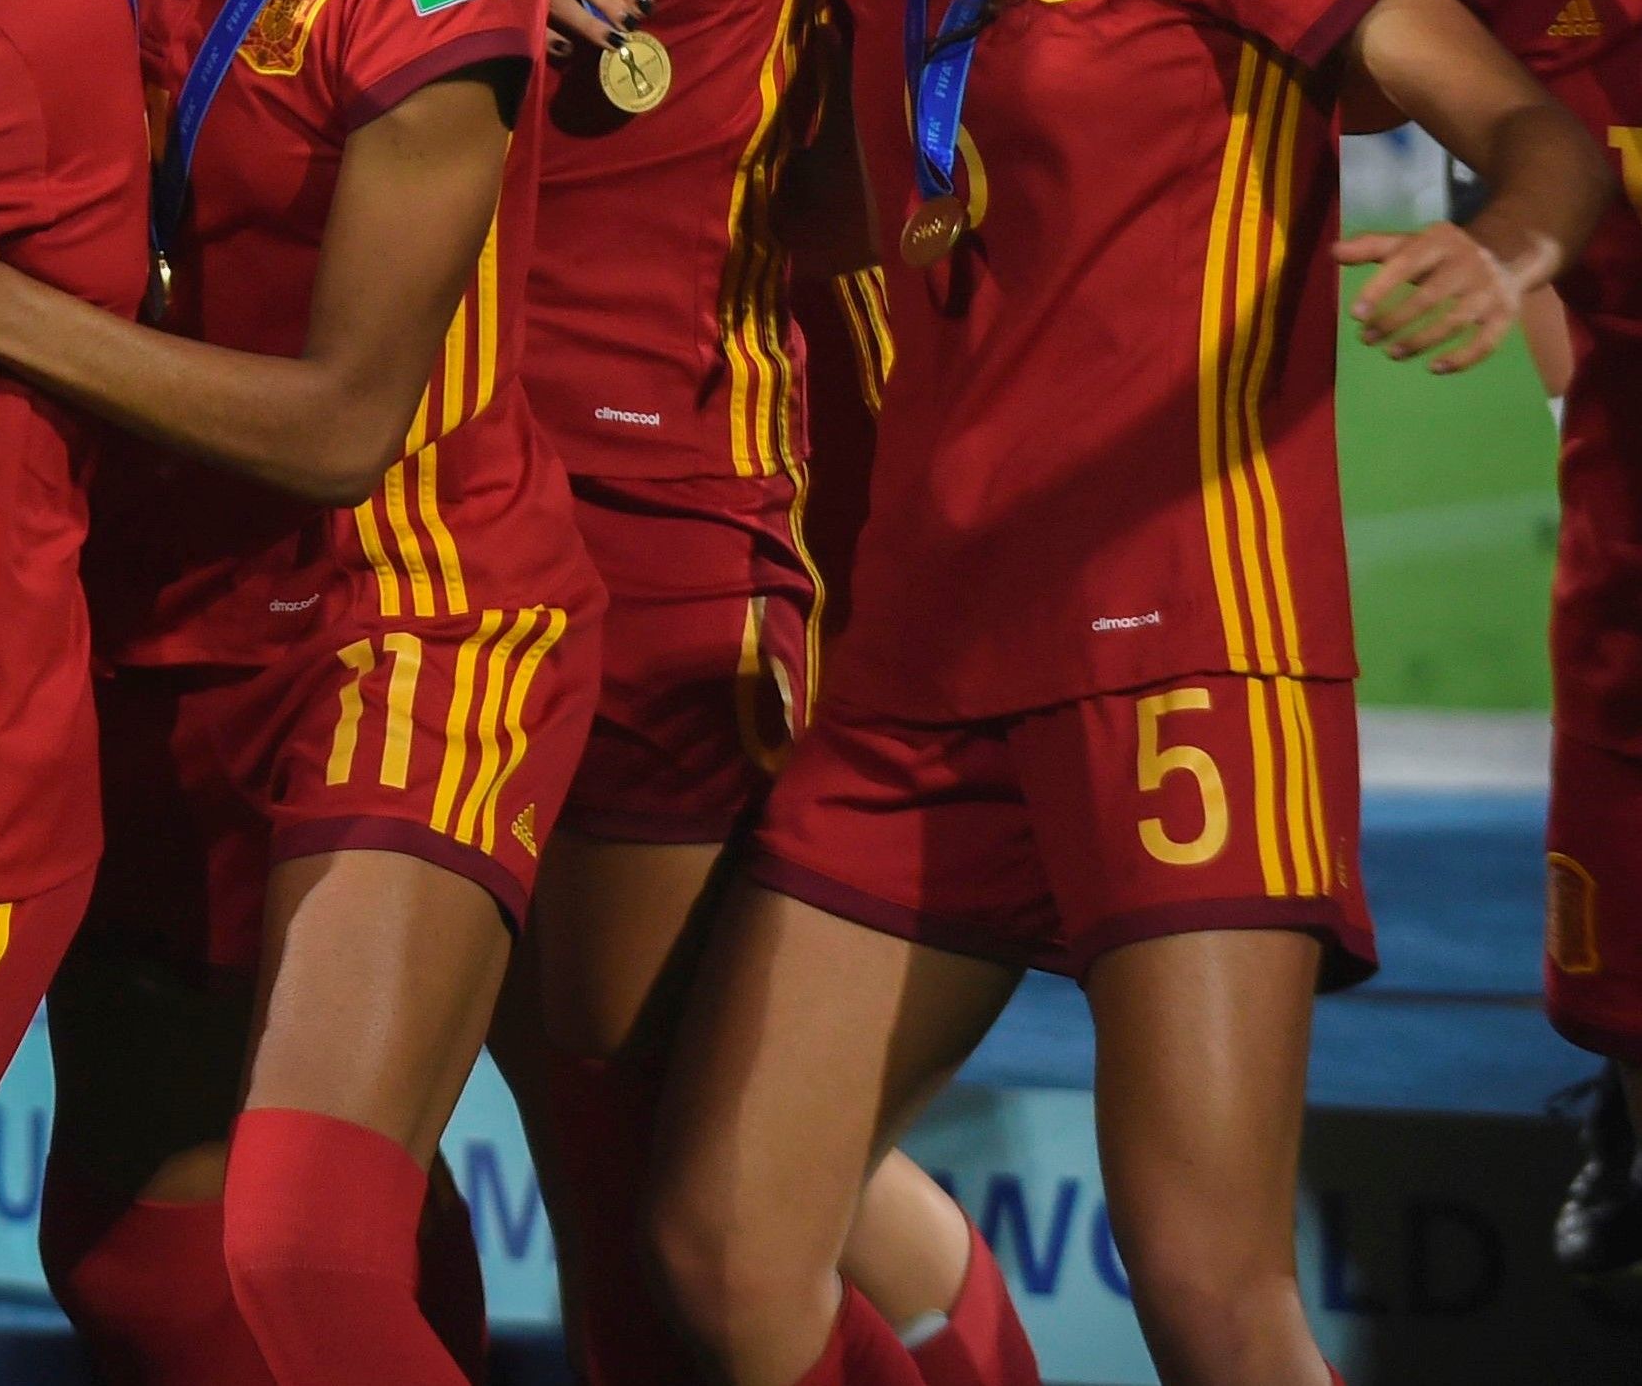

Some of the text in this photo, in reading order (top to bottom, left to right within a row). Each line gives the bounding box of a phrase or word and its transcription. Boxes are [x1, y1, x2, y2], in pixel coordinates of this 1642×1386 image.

[594, 406, 661, 426] climacool
[1091, 610, 1161, 631] climacool
[325, 631, 423, 790] 11
[1135, 684, 1231, 867] 5
